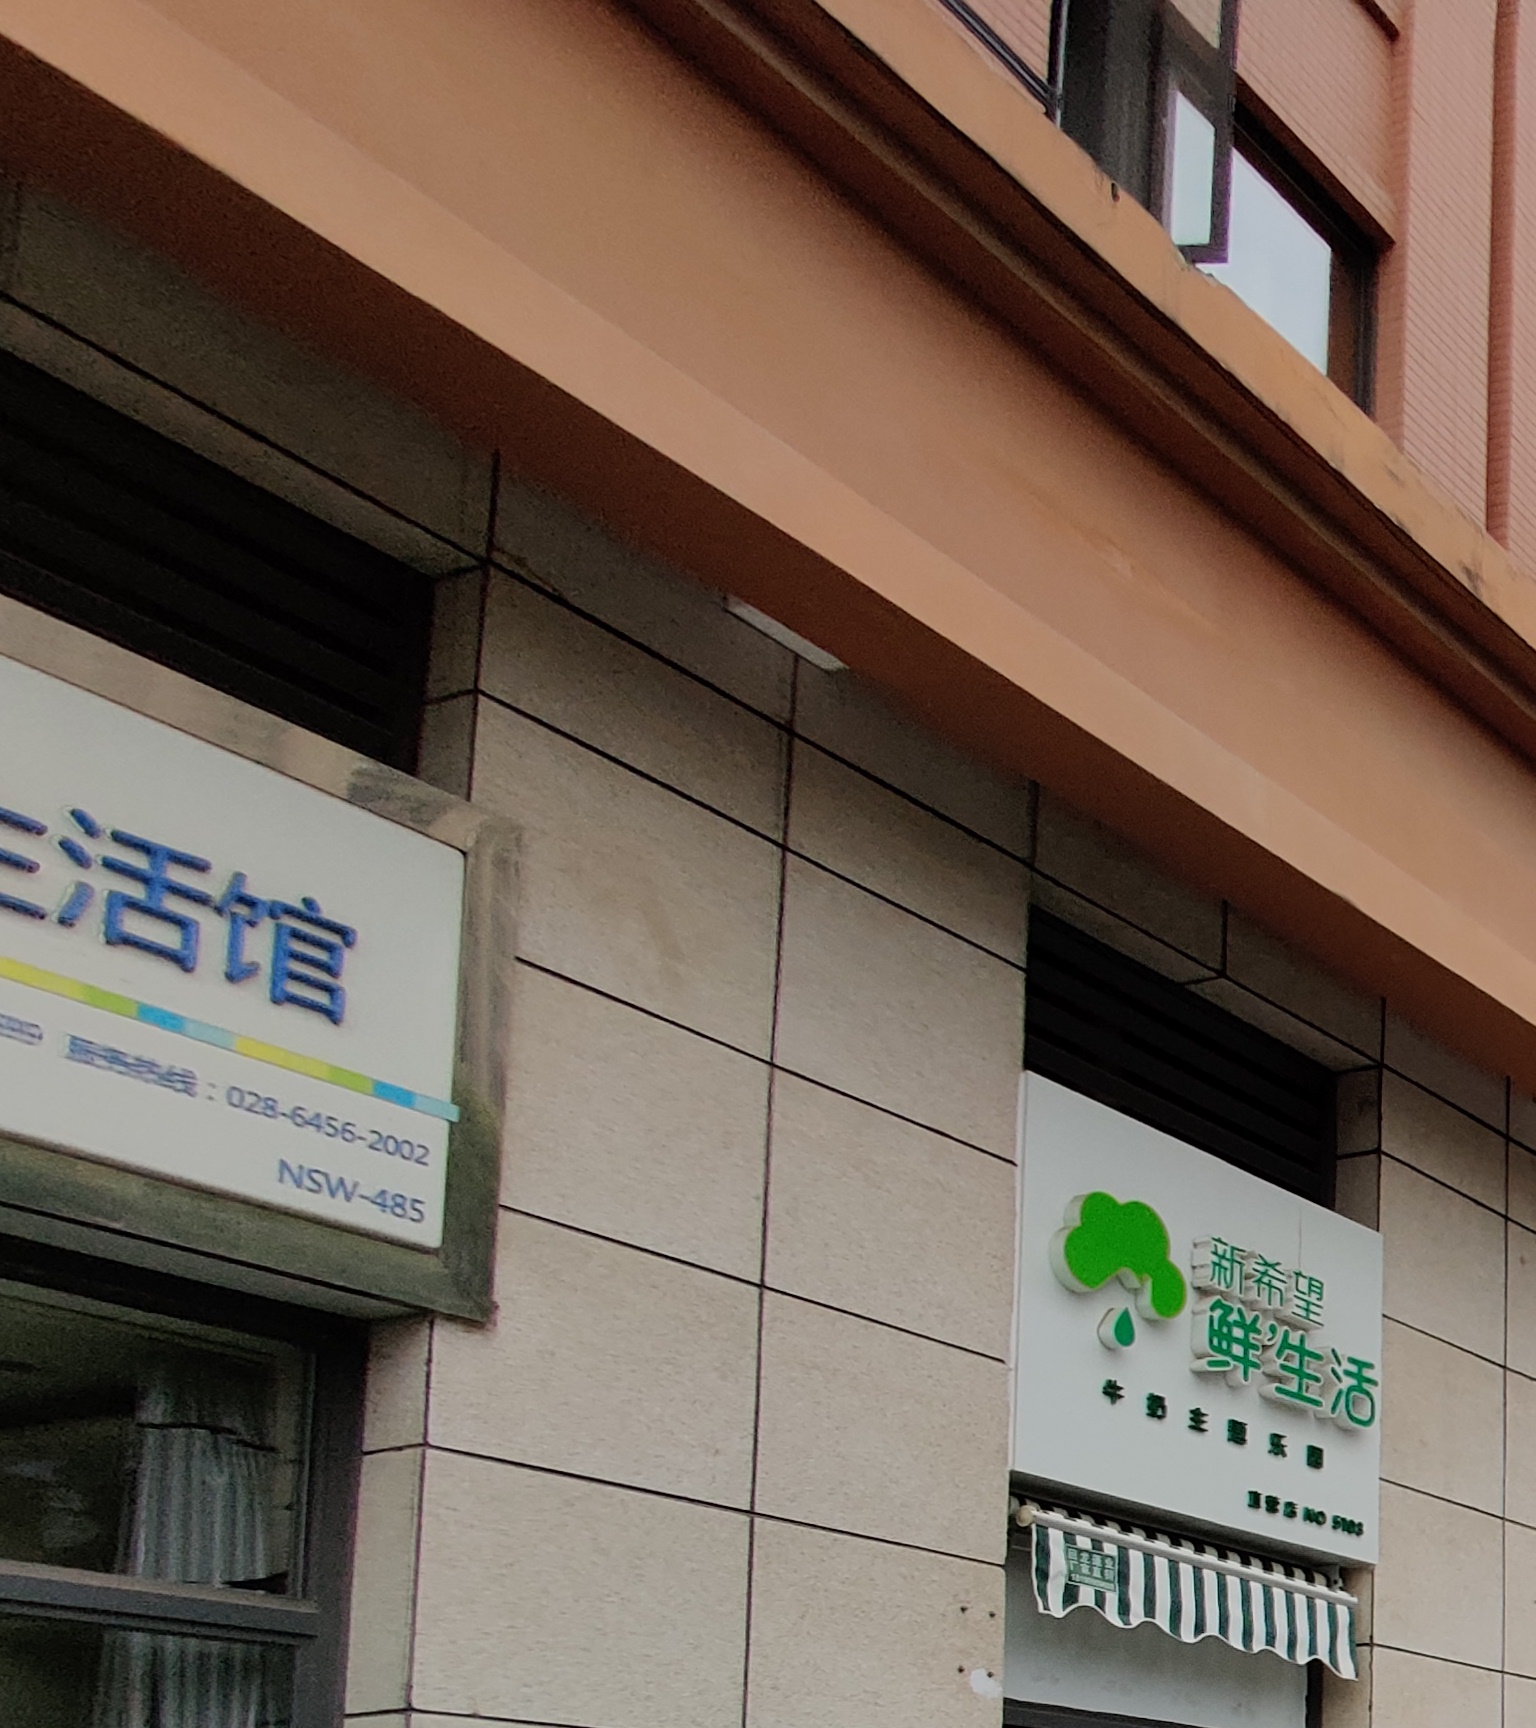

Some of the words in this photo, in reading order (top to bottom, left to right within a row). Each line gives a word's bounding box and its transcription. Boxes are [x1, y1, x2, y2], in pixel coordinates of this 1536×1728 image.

[277, 1157, 426, 1223] NSW-485
[1209, 1236, 1325, 1327] 新希望
